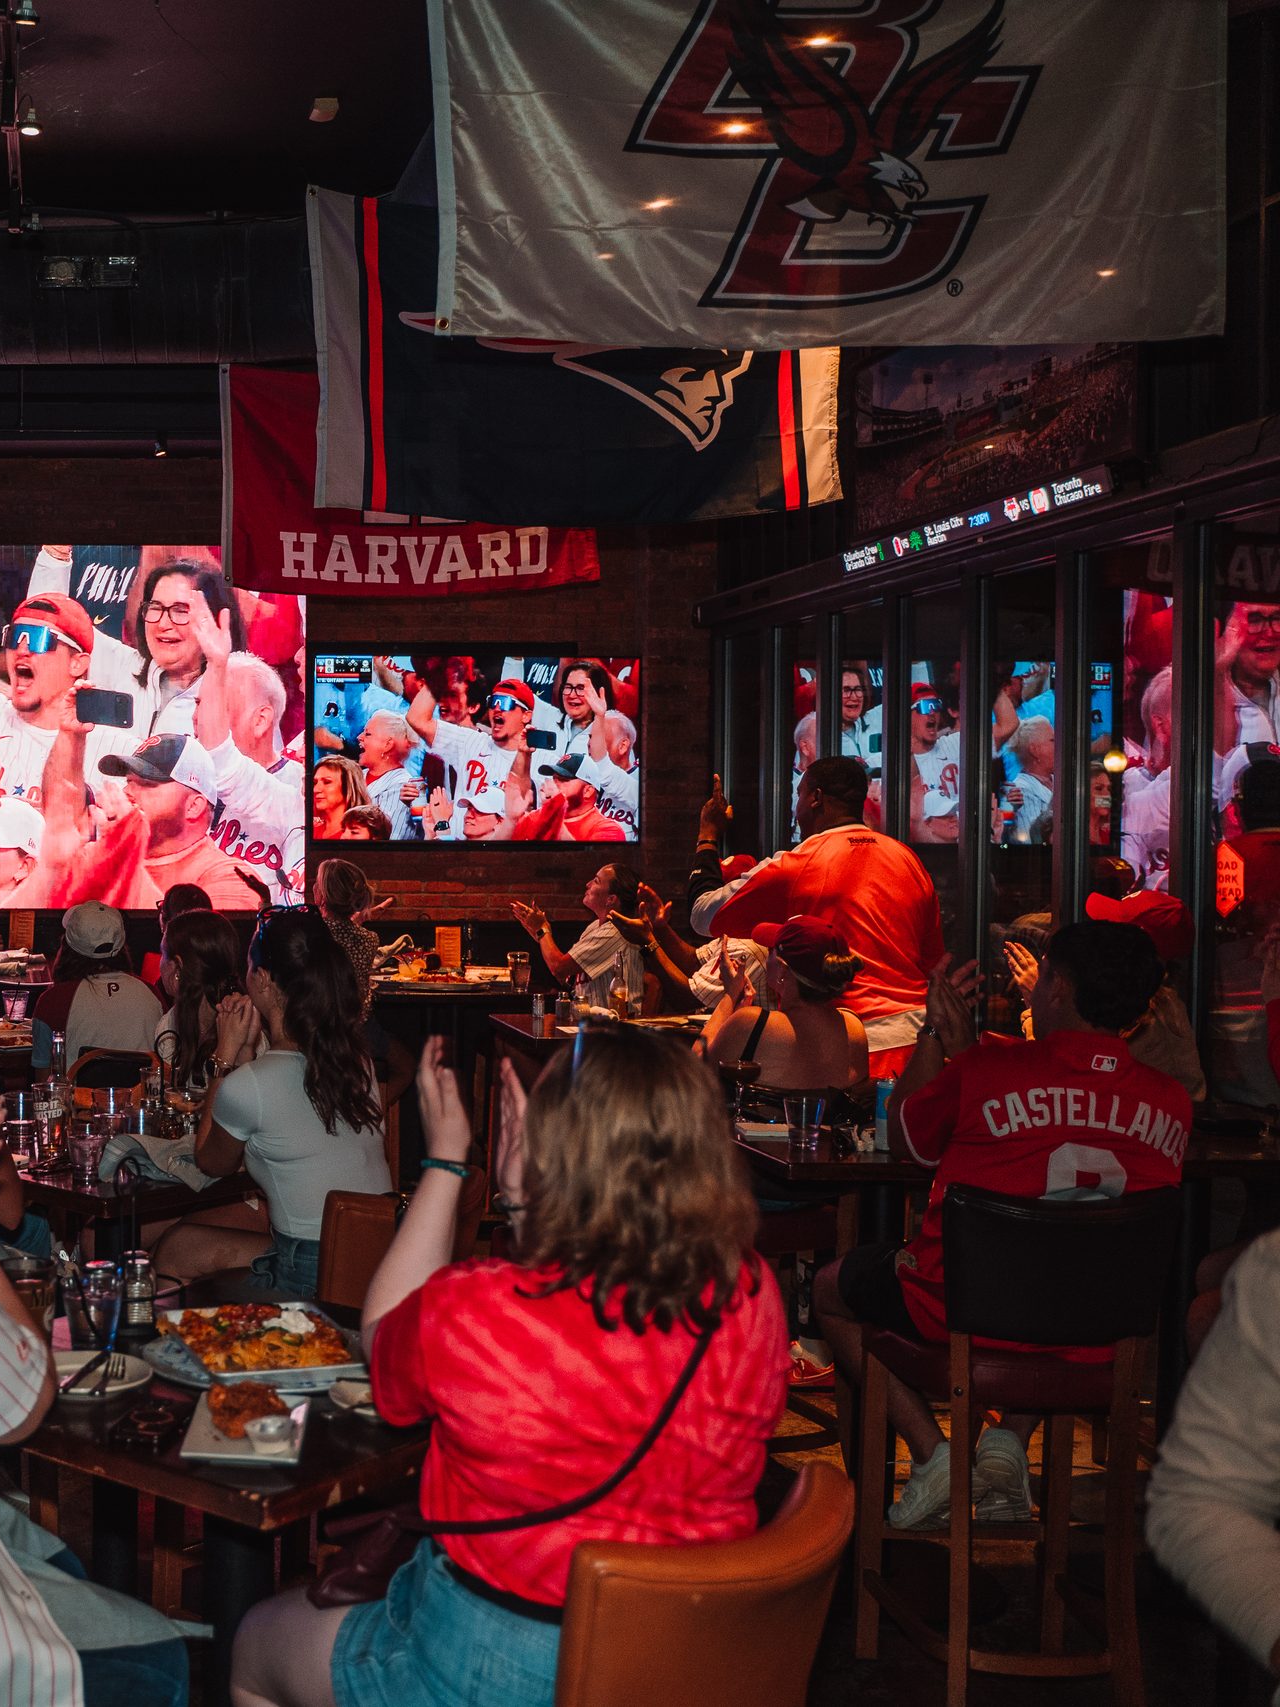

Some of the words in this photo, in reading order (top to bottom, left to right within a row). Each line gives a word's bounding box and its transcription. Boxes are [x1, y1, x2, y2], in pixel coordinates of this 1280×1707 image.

[1051, 477, 1082, 495] Toronto
[1054, 489, 1084, 506] Chicago
[1083, 484, 1103, 498] Fire
[933, 520, 951, 534] Louis
[949, 516, 964, 529] City
[968, 511, 990, 529] 7:30PM
[926, 533, 947, 546] Austin
[279, 526, 549, 585] HARVARD
[843, 550, 865, 562] Columbus
[845, 558, 866, 572] Orlando
[847, 836, 878, 845] Reebok
[1217, 861, 1238, 871] OAD
[1217, 874, 1239, 885] ORK
[1217, 887, 1242, 897] HEAD
[982, 1087, 1189, 1167] CASTELLANOS
